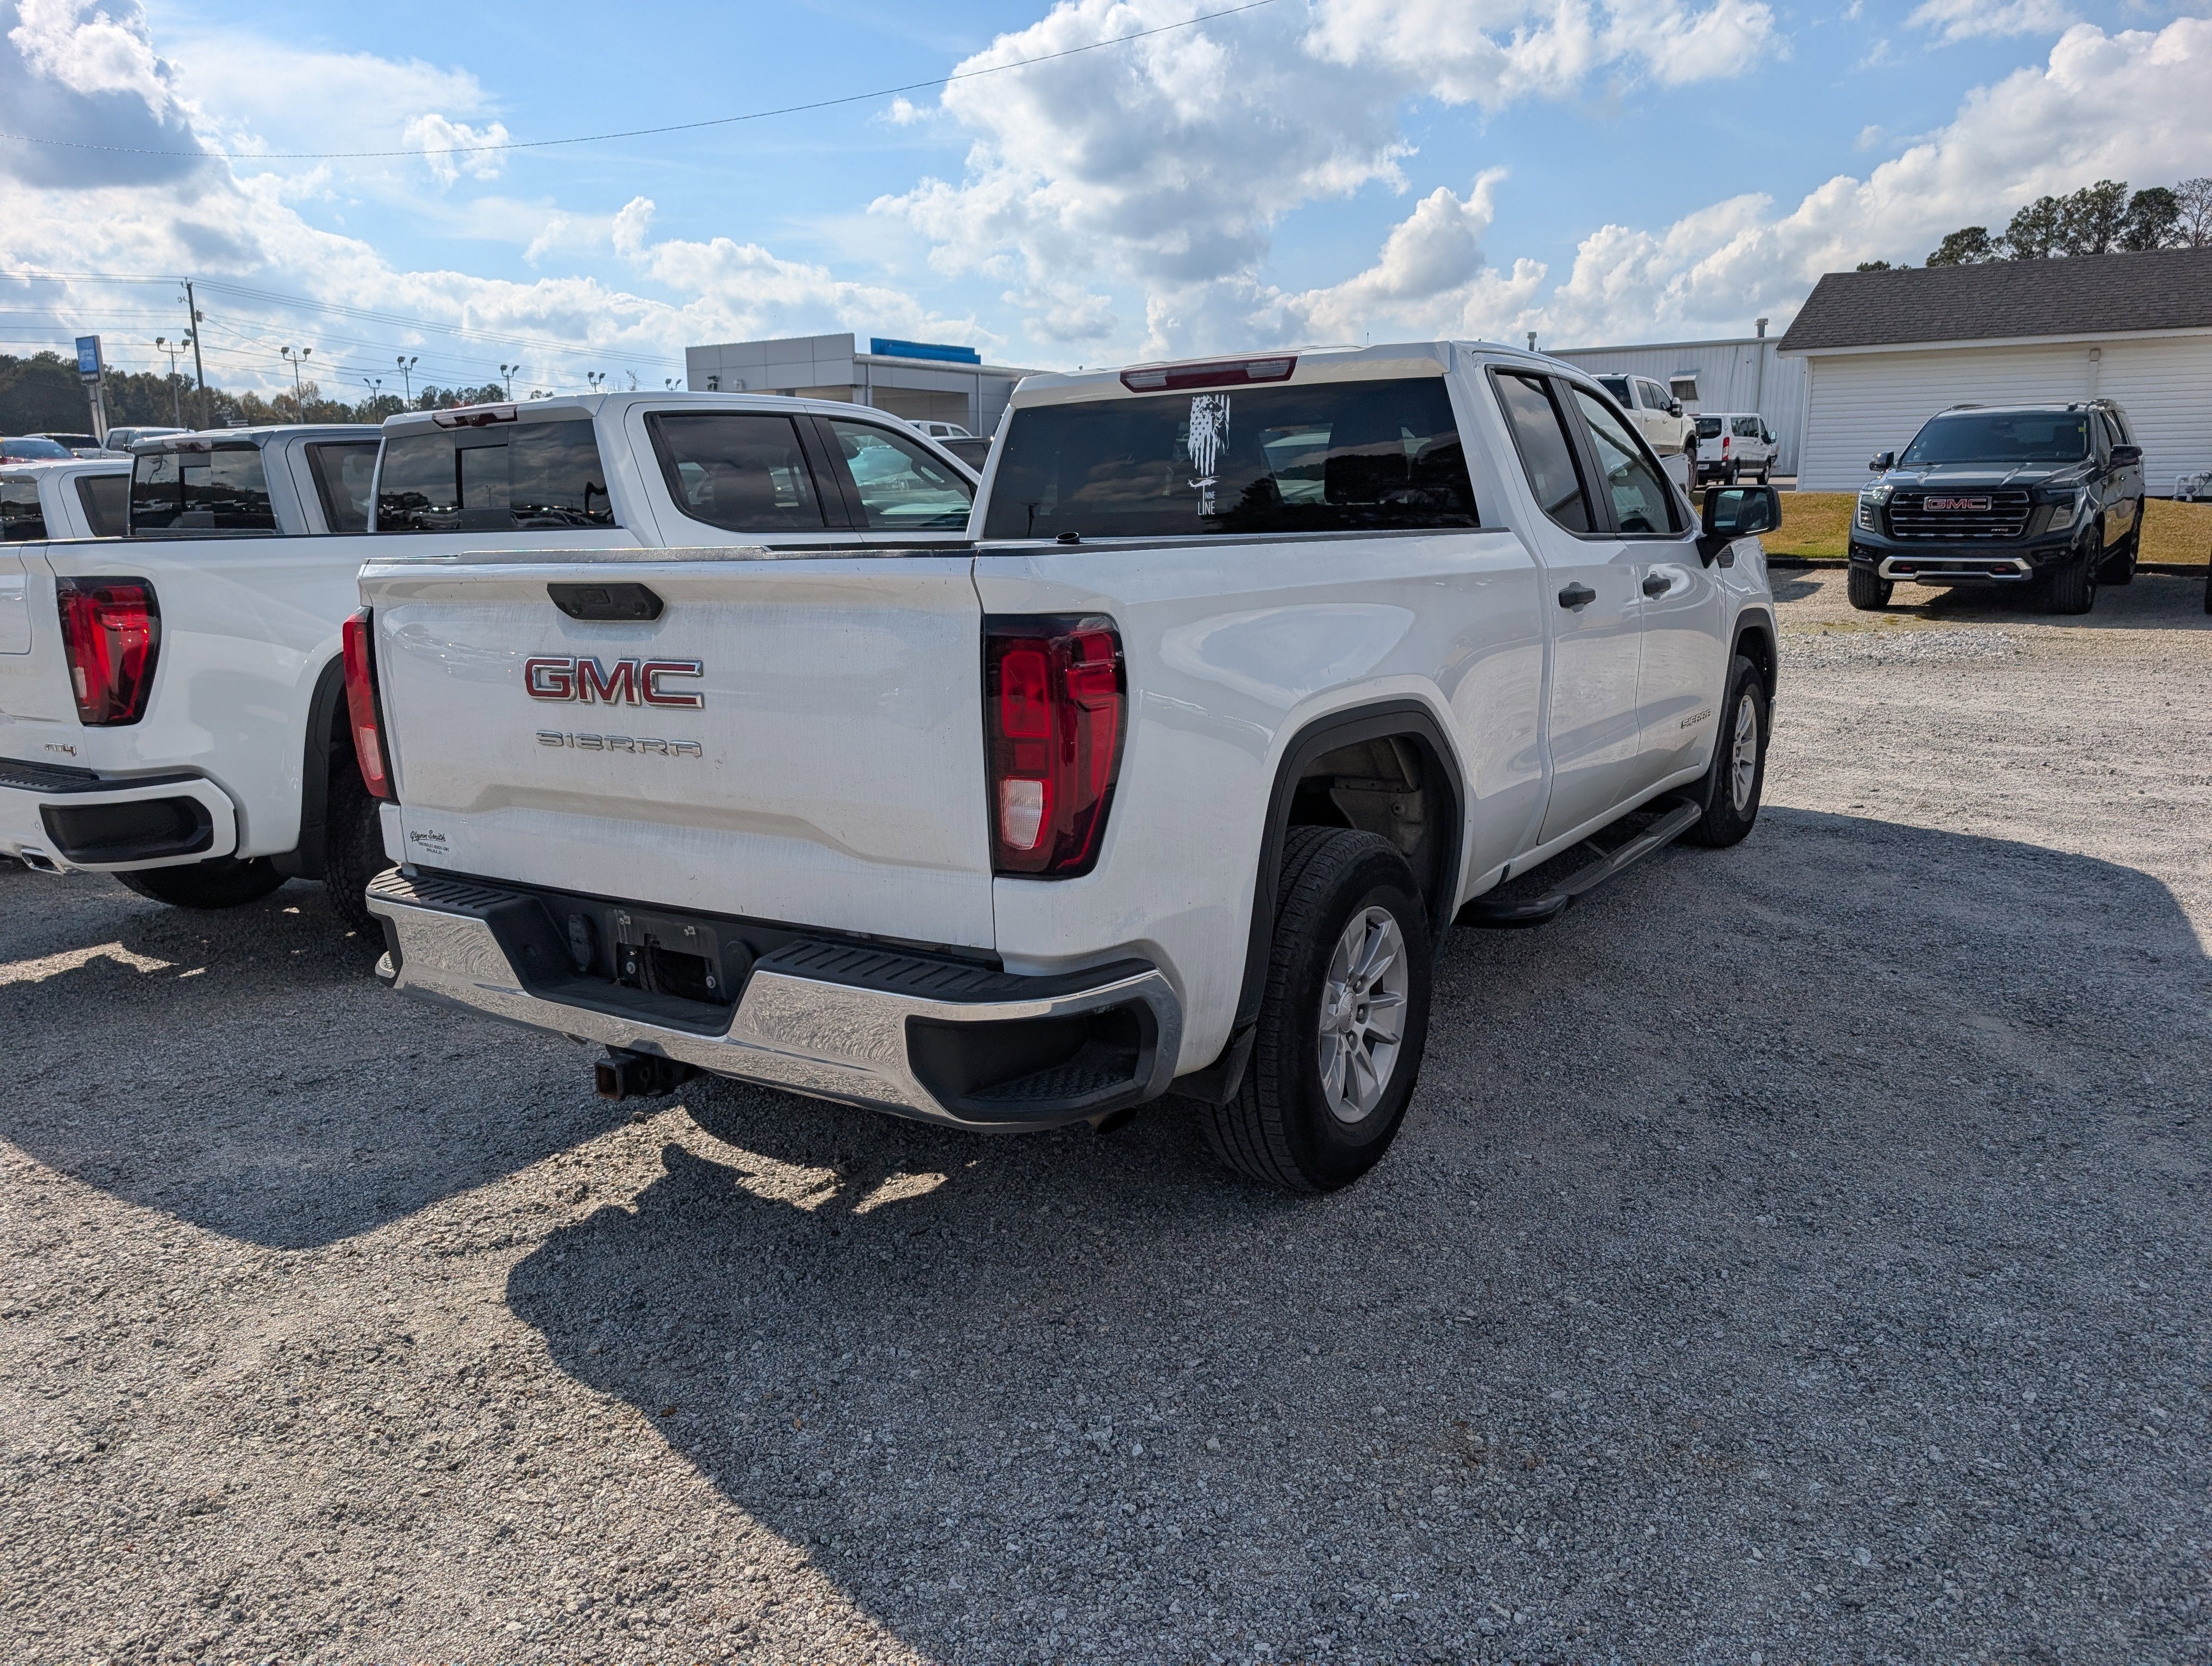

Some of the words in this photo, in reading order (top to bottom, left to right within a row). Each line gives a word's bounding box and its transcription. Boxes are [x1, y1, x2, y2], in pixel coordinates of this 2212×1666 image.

[1205, 491, 1216, 499] NINE
[1198, 501, 1216, 515] LINE
[1928, 498, 1987, 509] GMC
[525, 655, 704, 710] GMC
[1681, 708, 1711, 729] SIERRA
[535, 730, 703, 758] SIERRA
[410, 830, 428, 842] Glynn
[428, 829, 446, 842] Smith
